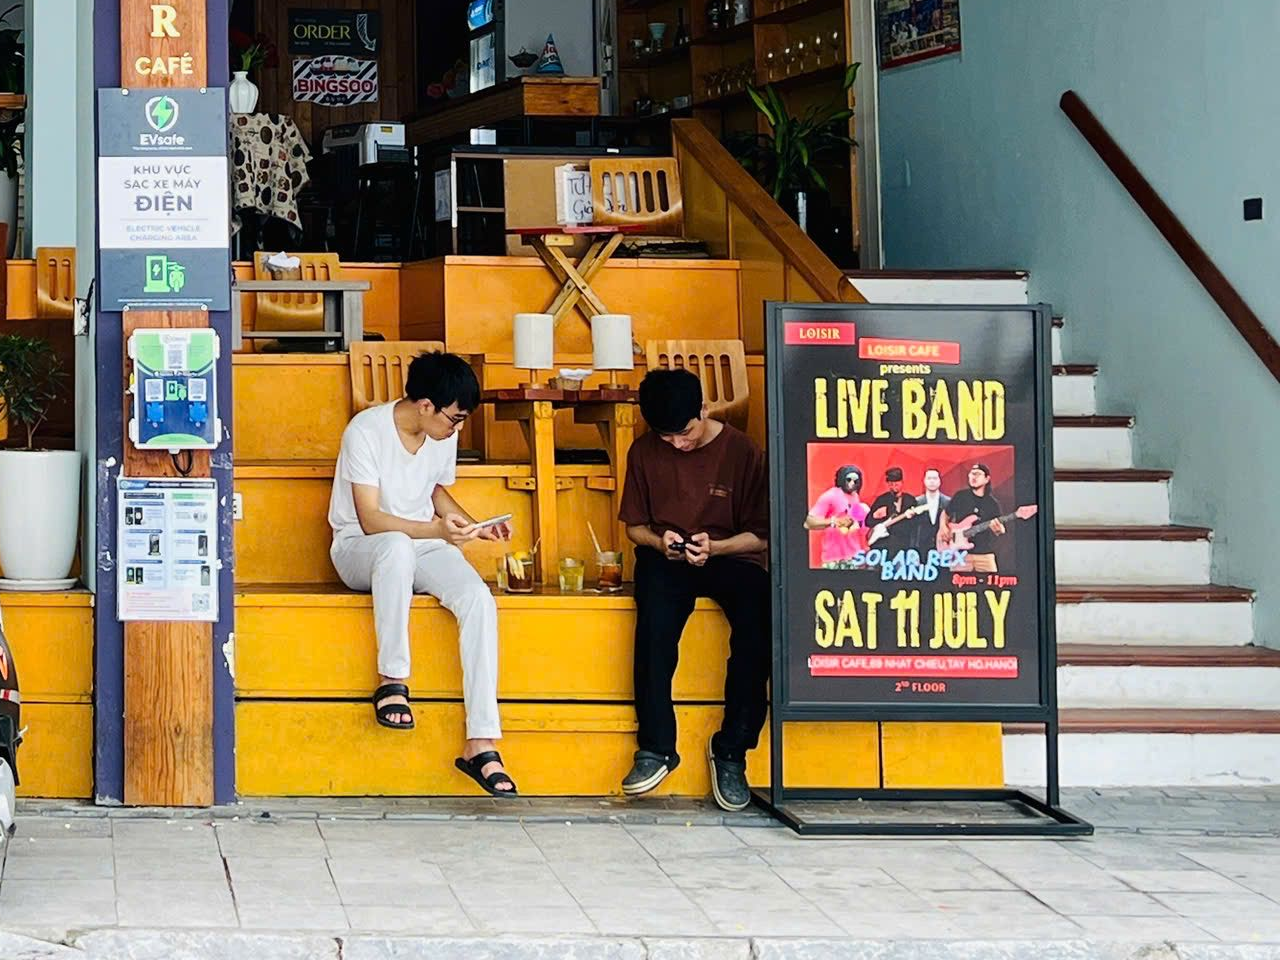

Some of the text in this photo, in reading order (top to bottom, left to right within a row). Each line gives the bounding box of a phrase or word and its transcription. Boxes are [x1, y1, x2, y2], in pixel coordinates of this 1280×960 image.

[293, 24, 351, 39] ORDER
[135, 52, 193, 76] CAFÉ
[297, 79, 374, 94] BINGSOO
[140, 133, 185, 145] EVsafe
[133, 165, 160, 175] KHU
[154, 180, 169, 189] XE
[134, 191, 193, 216] ĐIỆN
[799, 328, 841, 340] LOISIR
[867, 344, 940, 358] LOISIR CAFE
[880, 364, 931, 376] presents
[814, 377, 1006, 441] LIVE BAND
[853, 549, 969, 568] SOLAR REX
[881, 561, 939, 582] BAND
[952, 574, 977, 587] 8pm
[986, 574, 1018, 588] 11pm
[815, 589, 1011, 649] SAT 11 JULY
[912, 682, 946, 693] FLOOR
